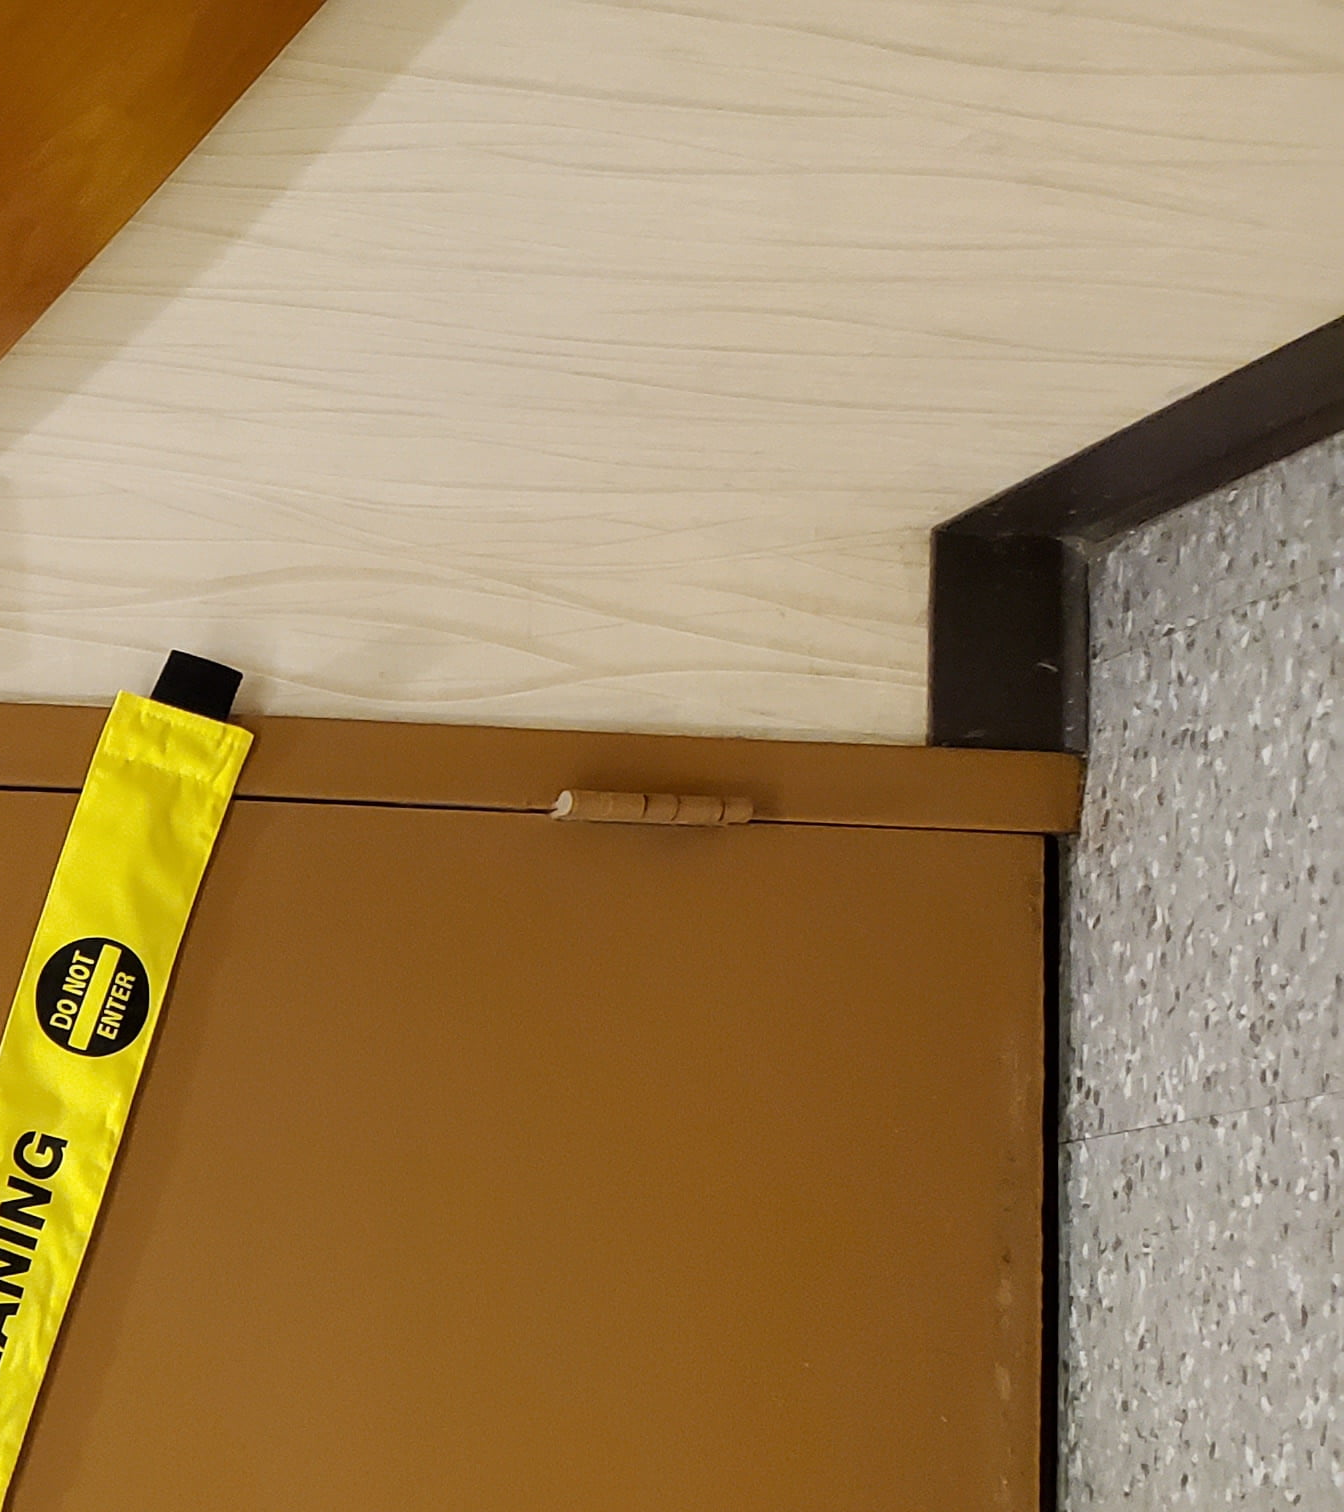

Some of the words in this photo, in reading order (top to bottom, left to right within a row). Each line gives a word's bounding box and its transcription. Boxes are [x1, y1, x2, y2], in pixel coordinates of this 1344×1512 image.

[62, 949, 95, 997] NOT
[49, 998, 78, 1031] DO
[96, 971, 136, 1040] ENTER
